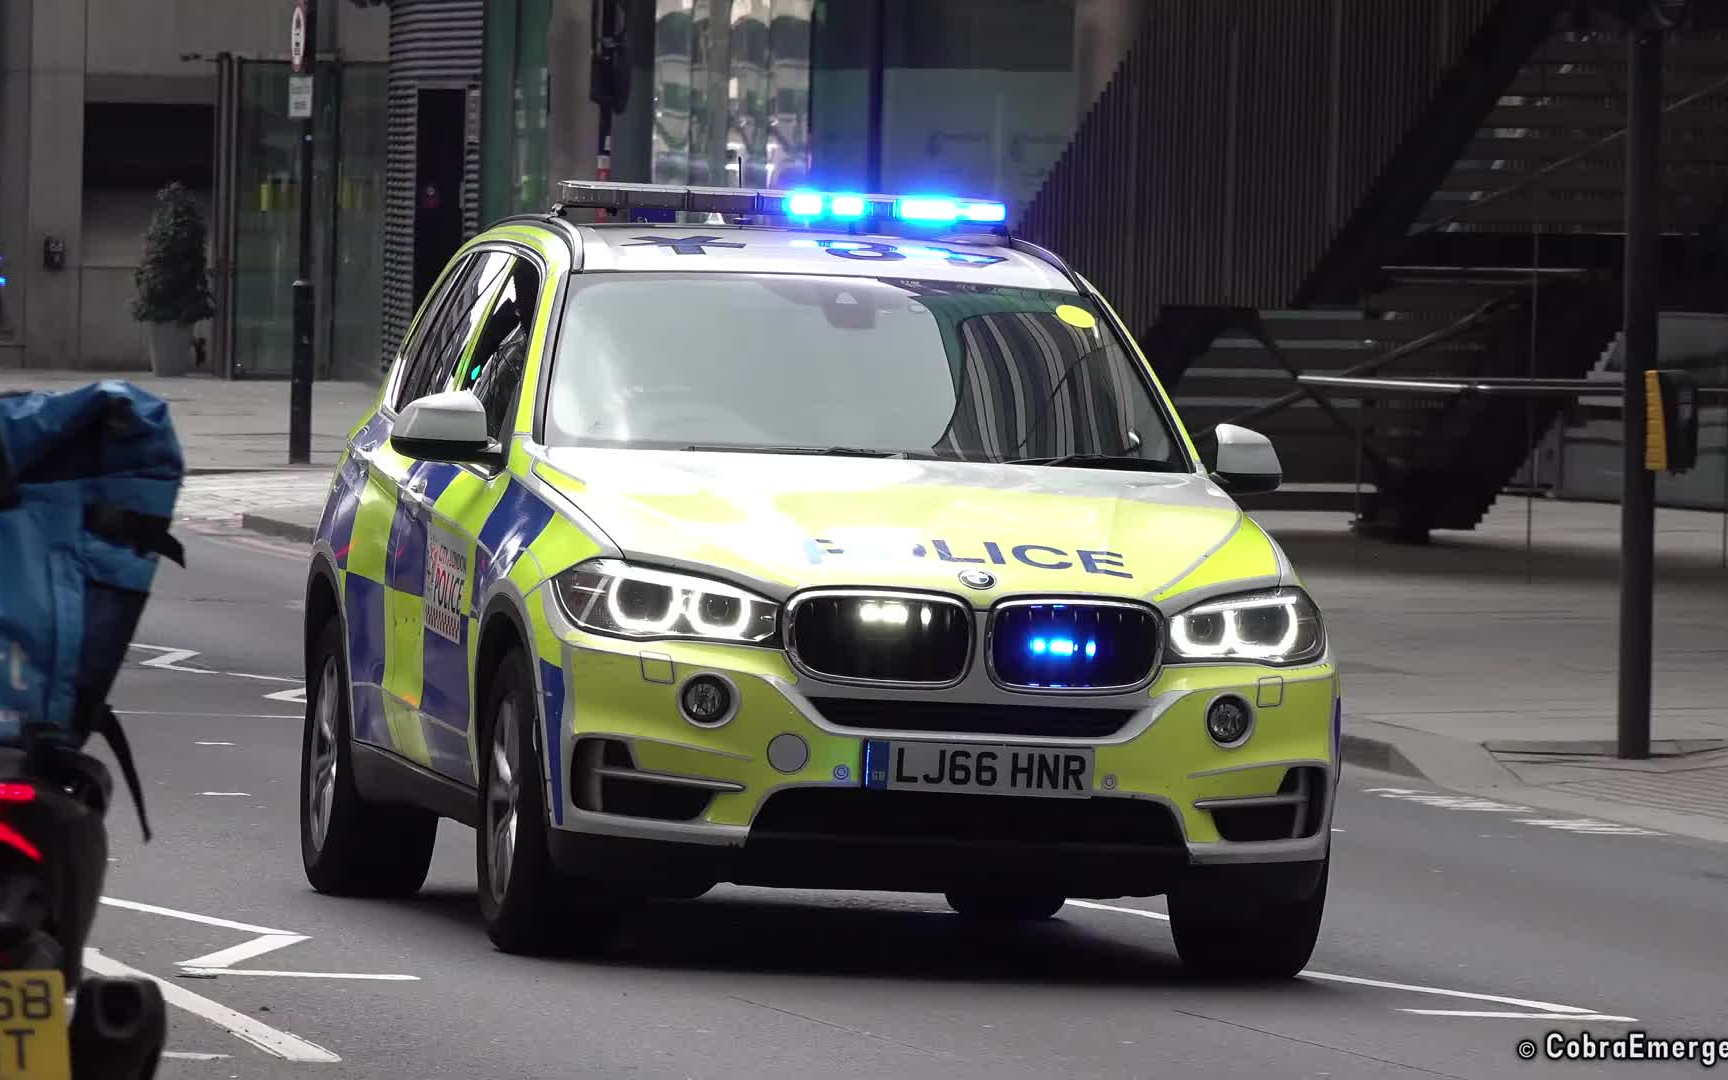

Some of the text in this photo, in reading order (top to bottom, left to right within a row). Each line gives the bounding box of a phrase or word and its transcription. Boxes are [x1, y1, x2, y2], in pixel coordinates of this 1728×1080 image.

[433, 567, 465, 615] POLICE
[895, 747, 1086, 791] LJ66 HNR
